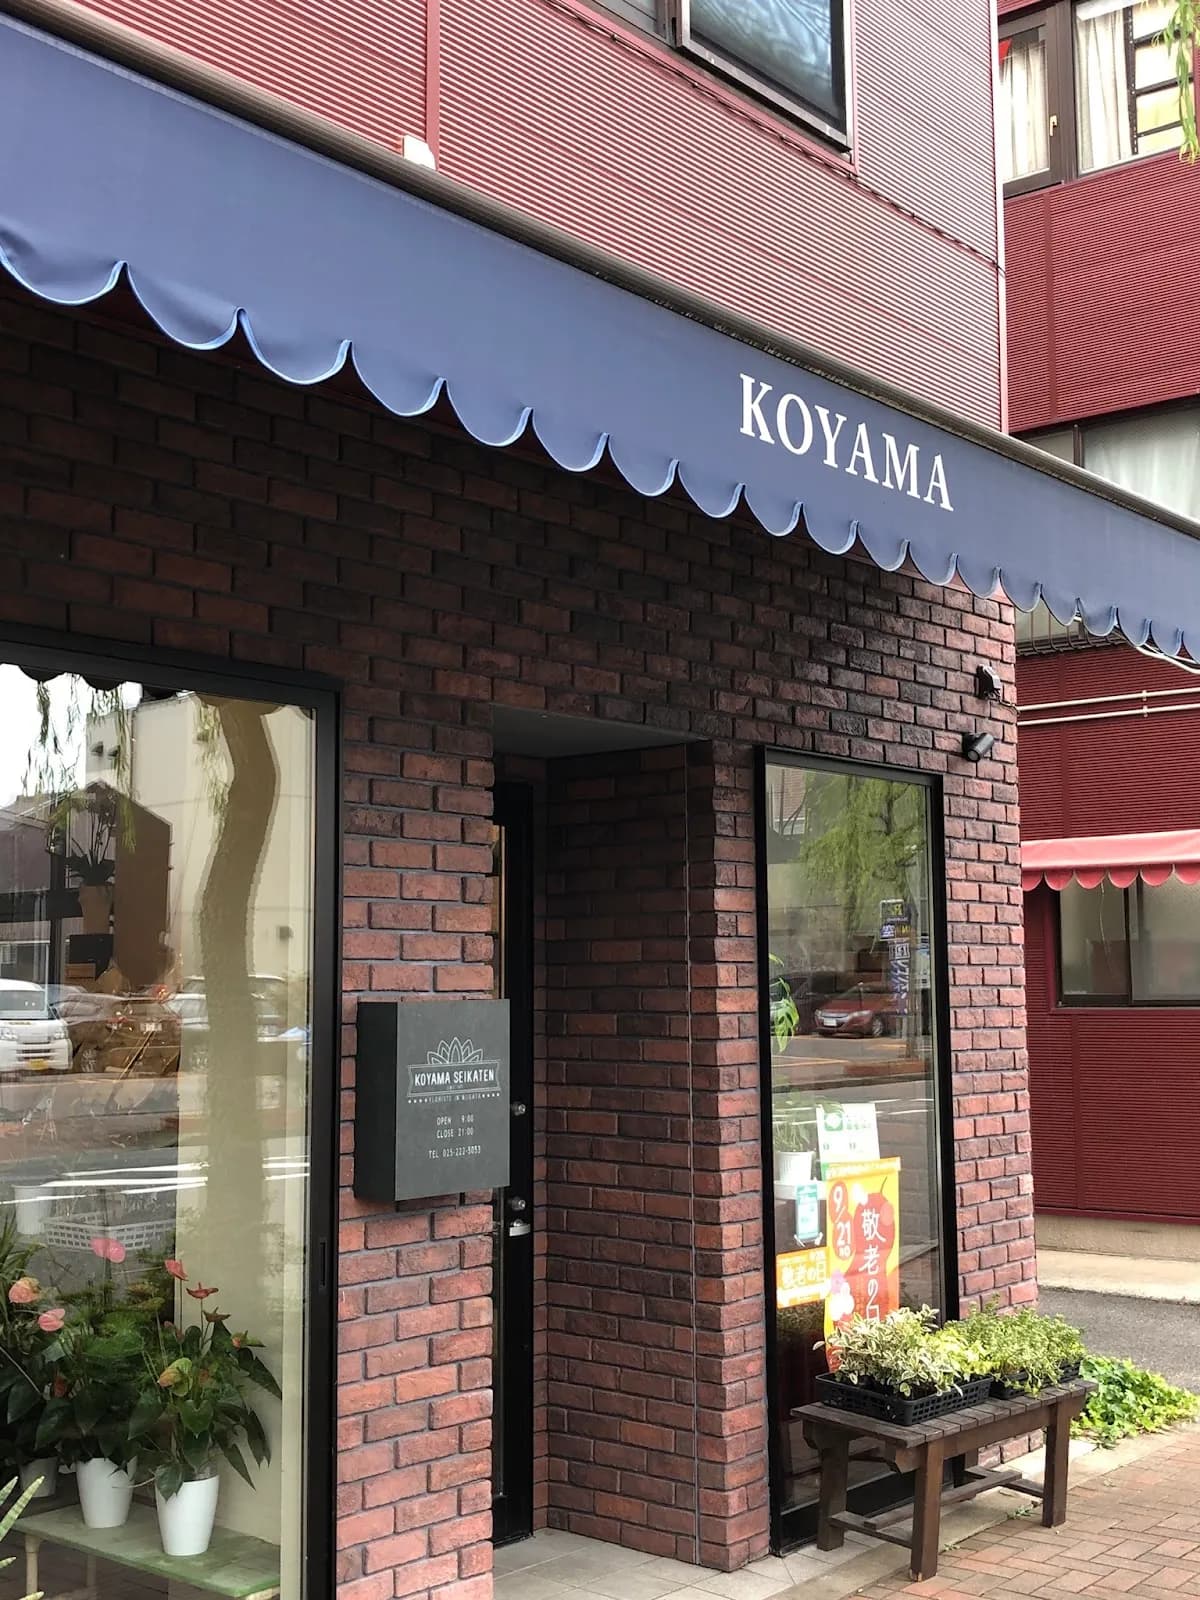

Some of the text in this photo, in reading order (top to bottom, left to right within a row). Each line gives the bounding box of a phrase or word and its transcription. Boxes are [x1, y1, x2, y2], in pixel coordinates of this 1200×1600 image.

[739, 373, 954, 512] KOYAMA
[414, 1068, 495, 1087] KOYAMA SEIKATEN
[436, 1116, 452, 1126] OPEN
[436, 1127, 474, 1139] CLOSE 21:00
[428, 1149, 439, 1159] TEL
